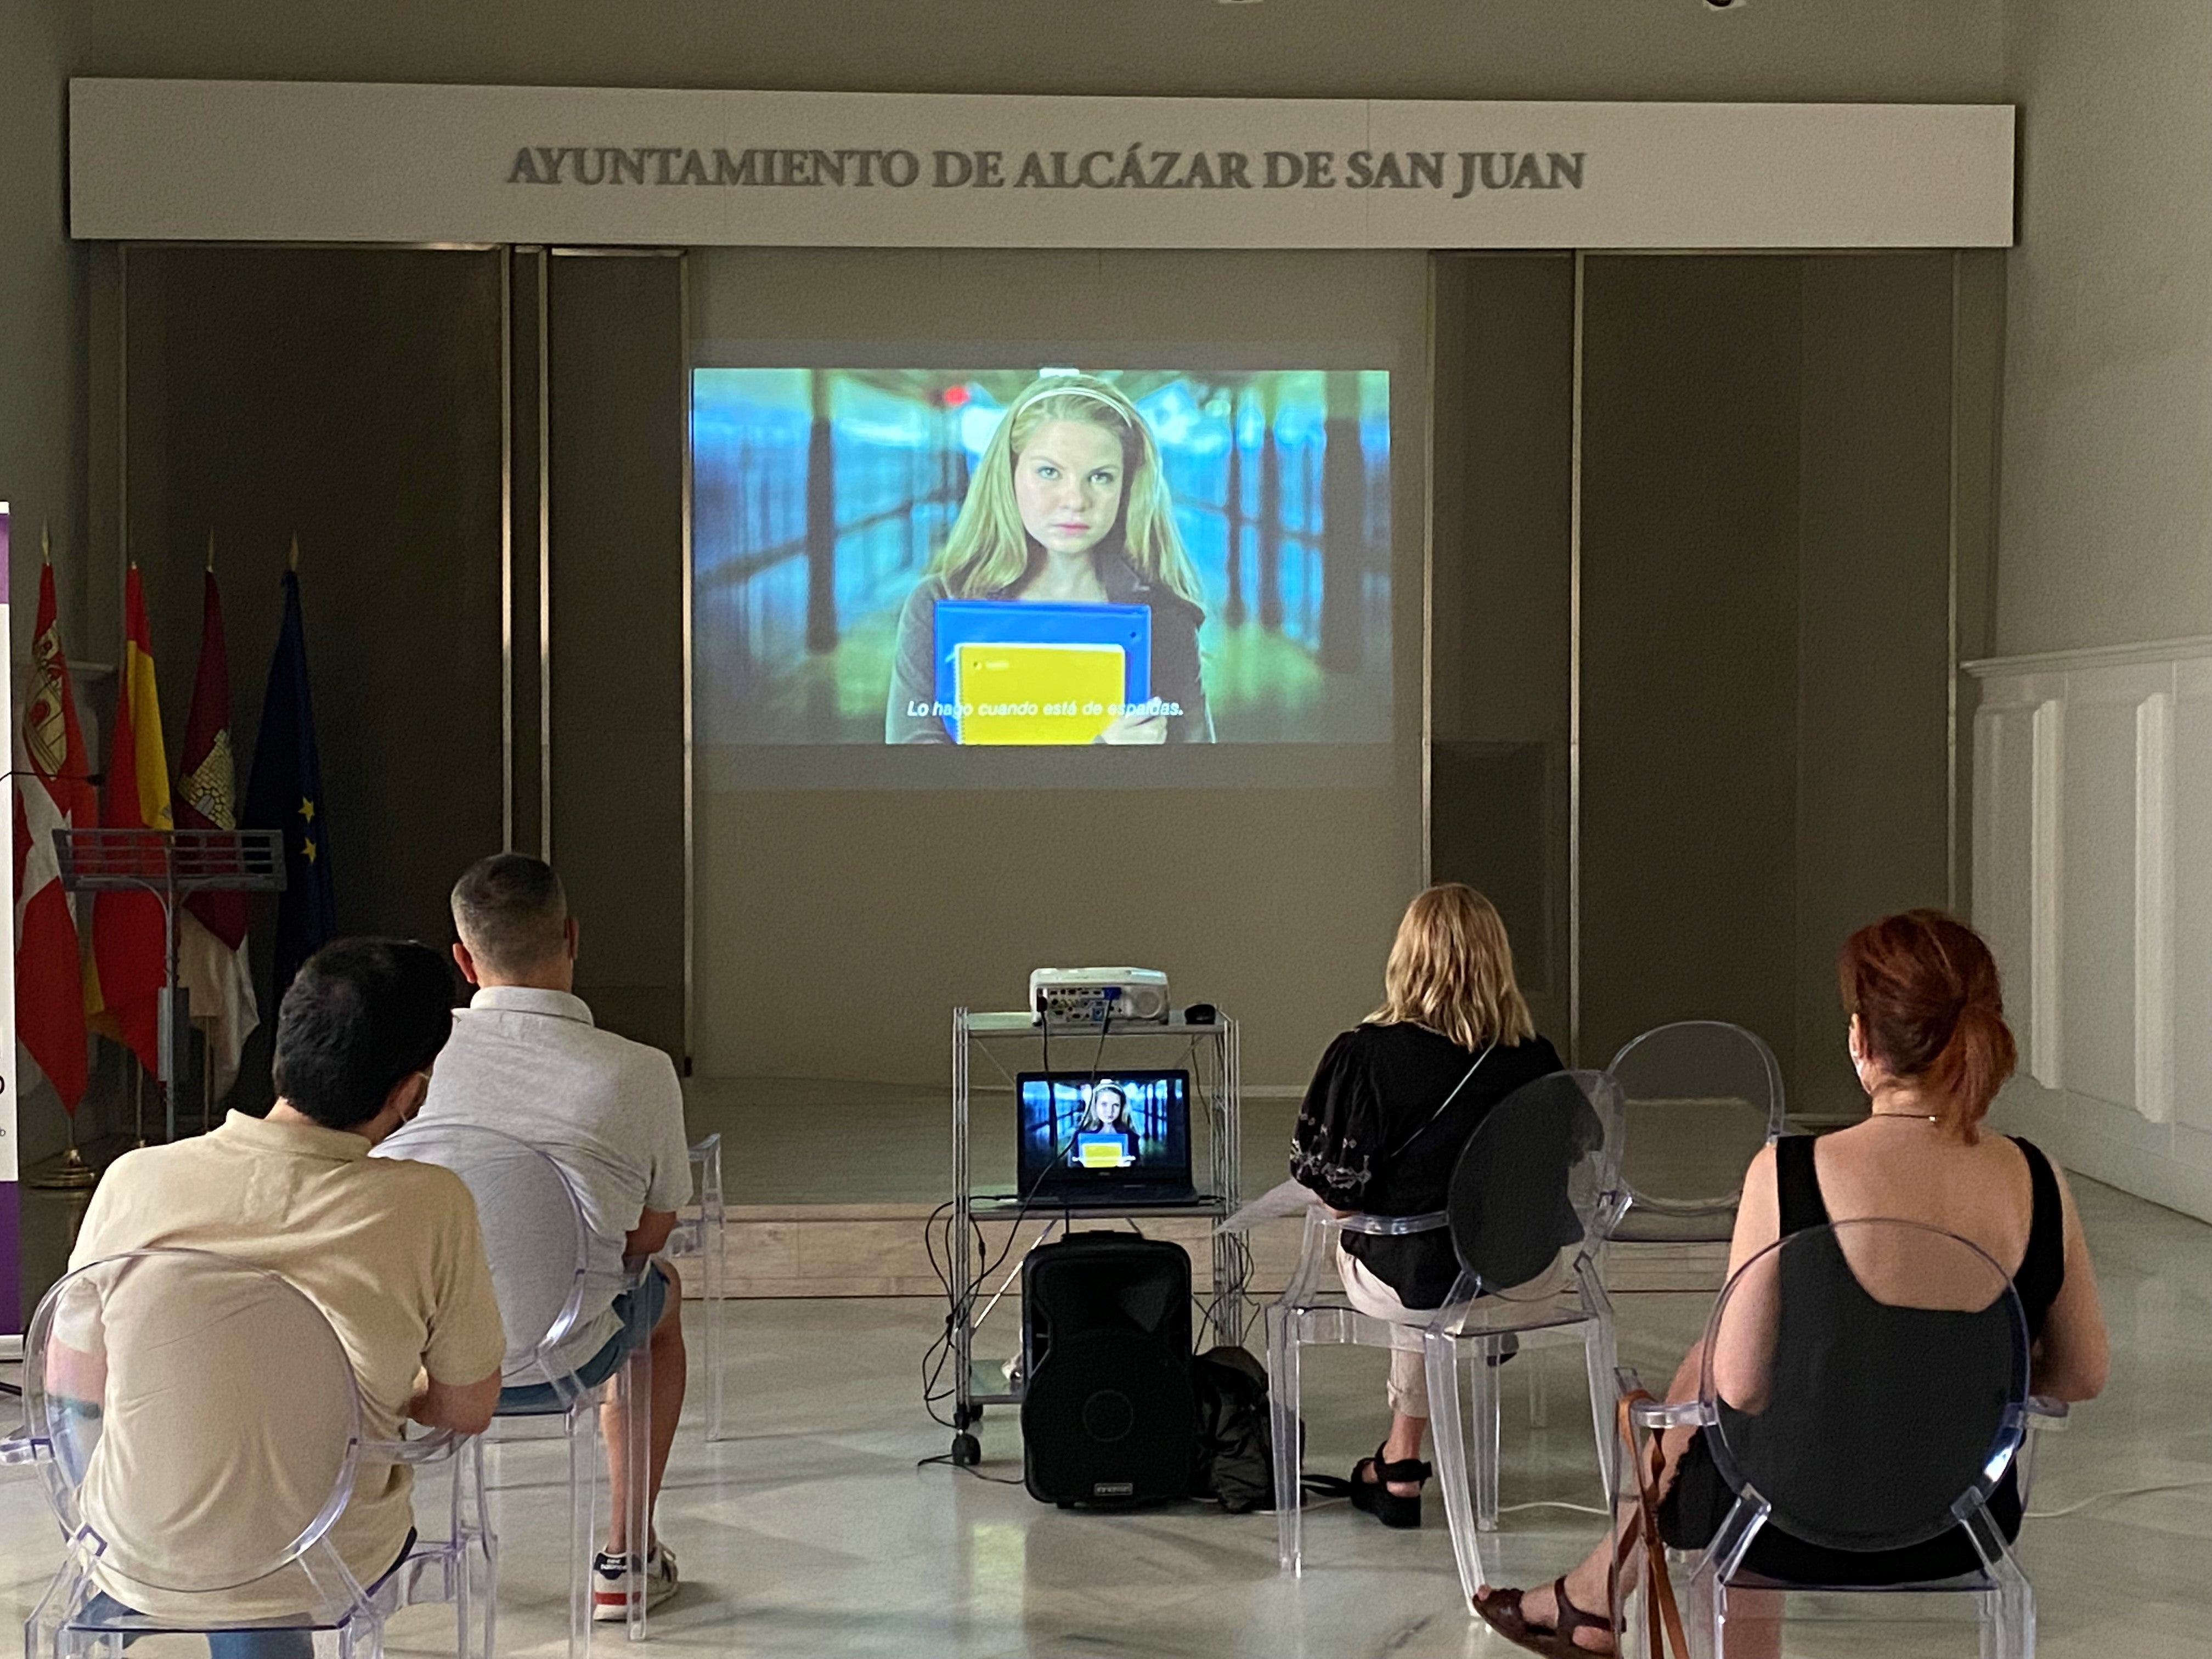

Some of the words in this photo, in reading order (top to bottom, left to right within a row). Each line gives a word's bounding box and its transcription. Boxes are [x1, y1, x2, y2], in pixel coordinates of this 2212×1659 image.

[507, 146, 919, 188] AYUNTAMIENTO
[932, 150, 1005, 188] DE
[1014, 141, 1252, 189] ALCÁZAR
[1262, 151, 1335, 189] DE
[1345, 151, 1445, 189] SAN
[1452, 151, 1587, 199] JUAN
[907, 701, 929, 716] Lo
[932, 701, 974, 718] hago
[978, 701, 1039, 716] cuando
[1042, 699, 1077, 715] está
[1082, 700, 1103, 715] de
[1107, 699, 1184, 718] espaldas.
